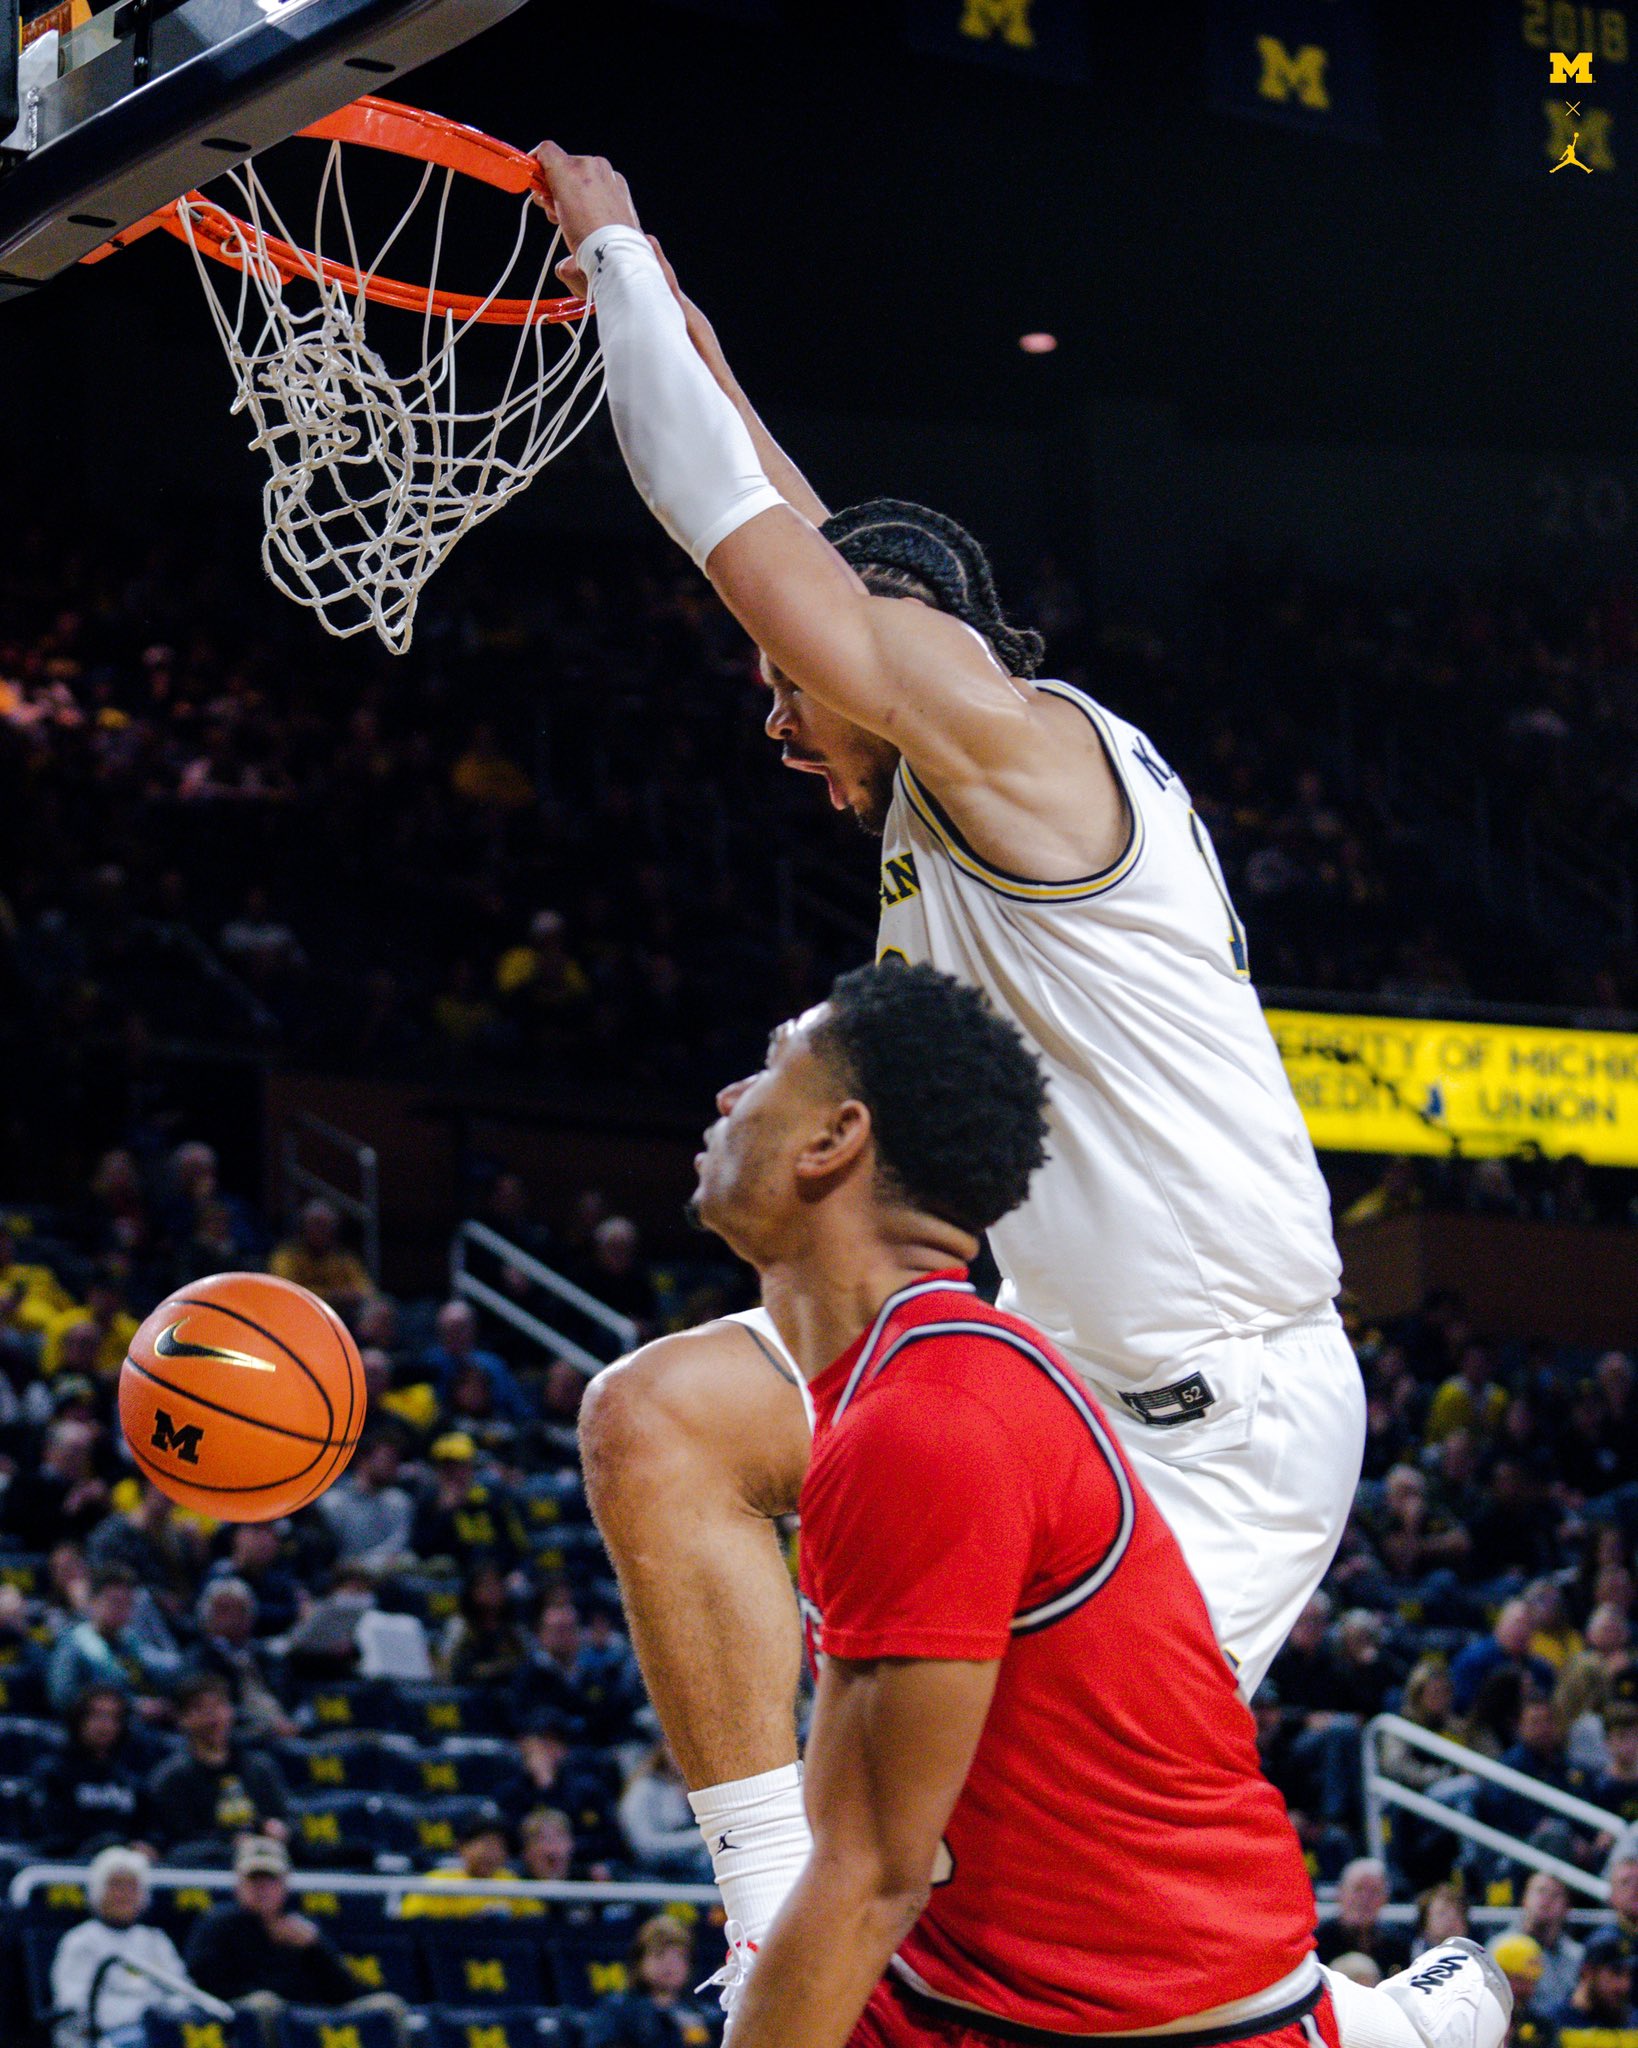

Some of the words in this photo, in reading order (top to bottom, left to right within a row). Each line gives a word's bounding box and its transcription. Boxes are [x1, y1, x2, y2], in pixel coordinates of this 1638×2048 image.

[1522, 0, 1629, 62] 2018
[1256, 35, 1330, 110] M
[1437, 1033, 1489, 1076] OF
[1508, 1042, 1638, 1083] MICHI
[1478, 1085, 1618, 1124] UNION
[1181, 1385, 1204, 1404] 52
[151, 1407, 205, 1465] M
